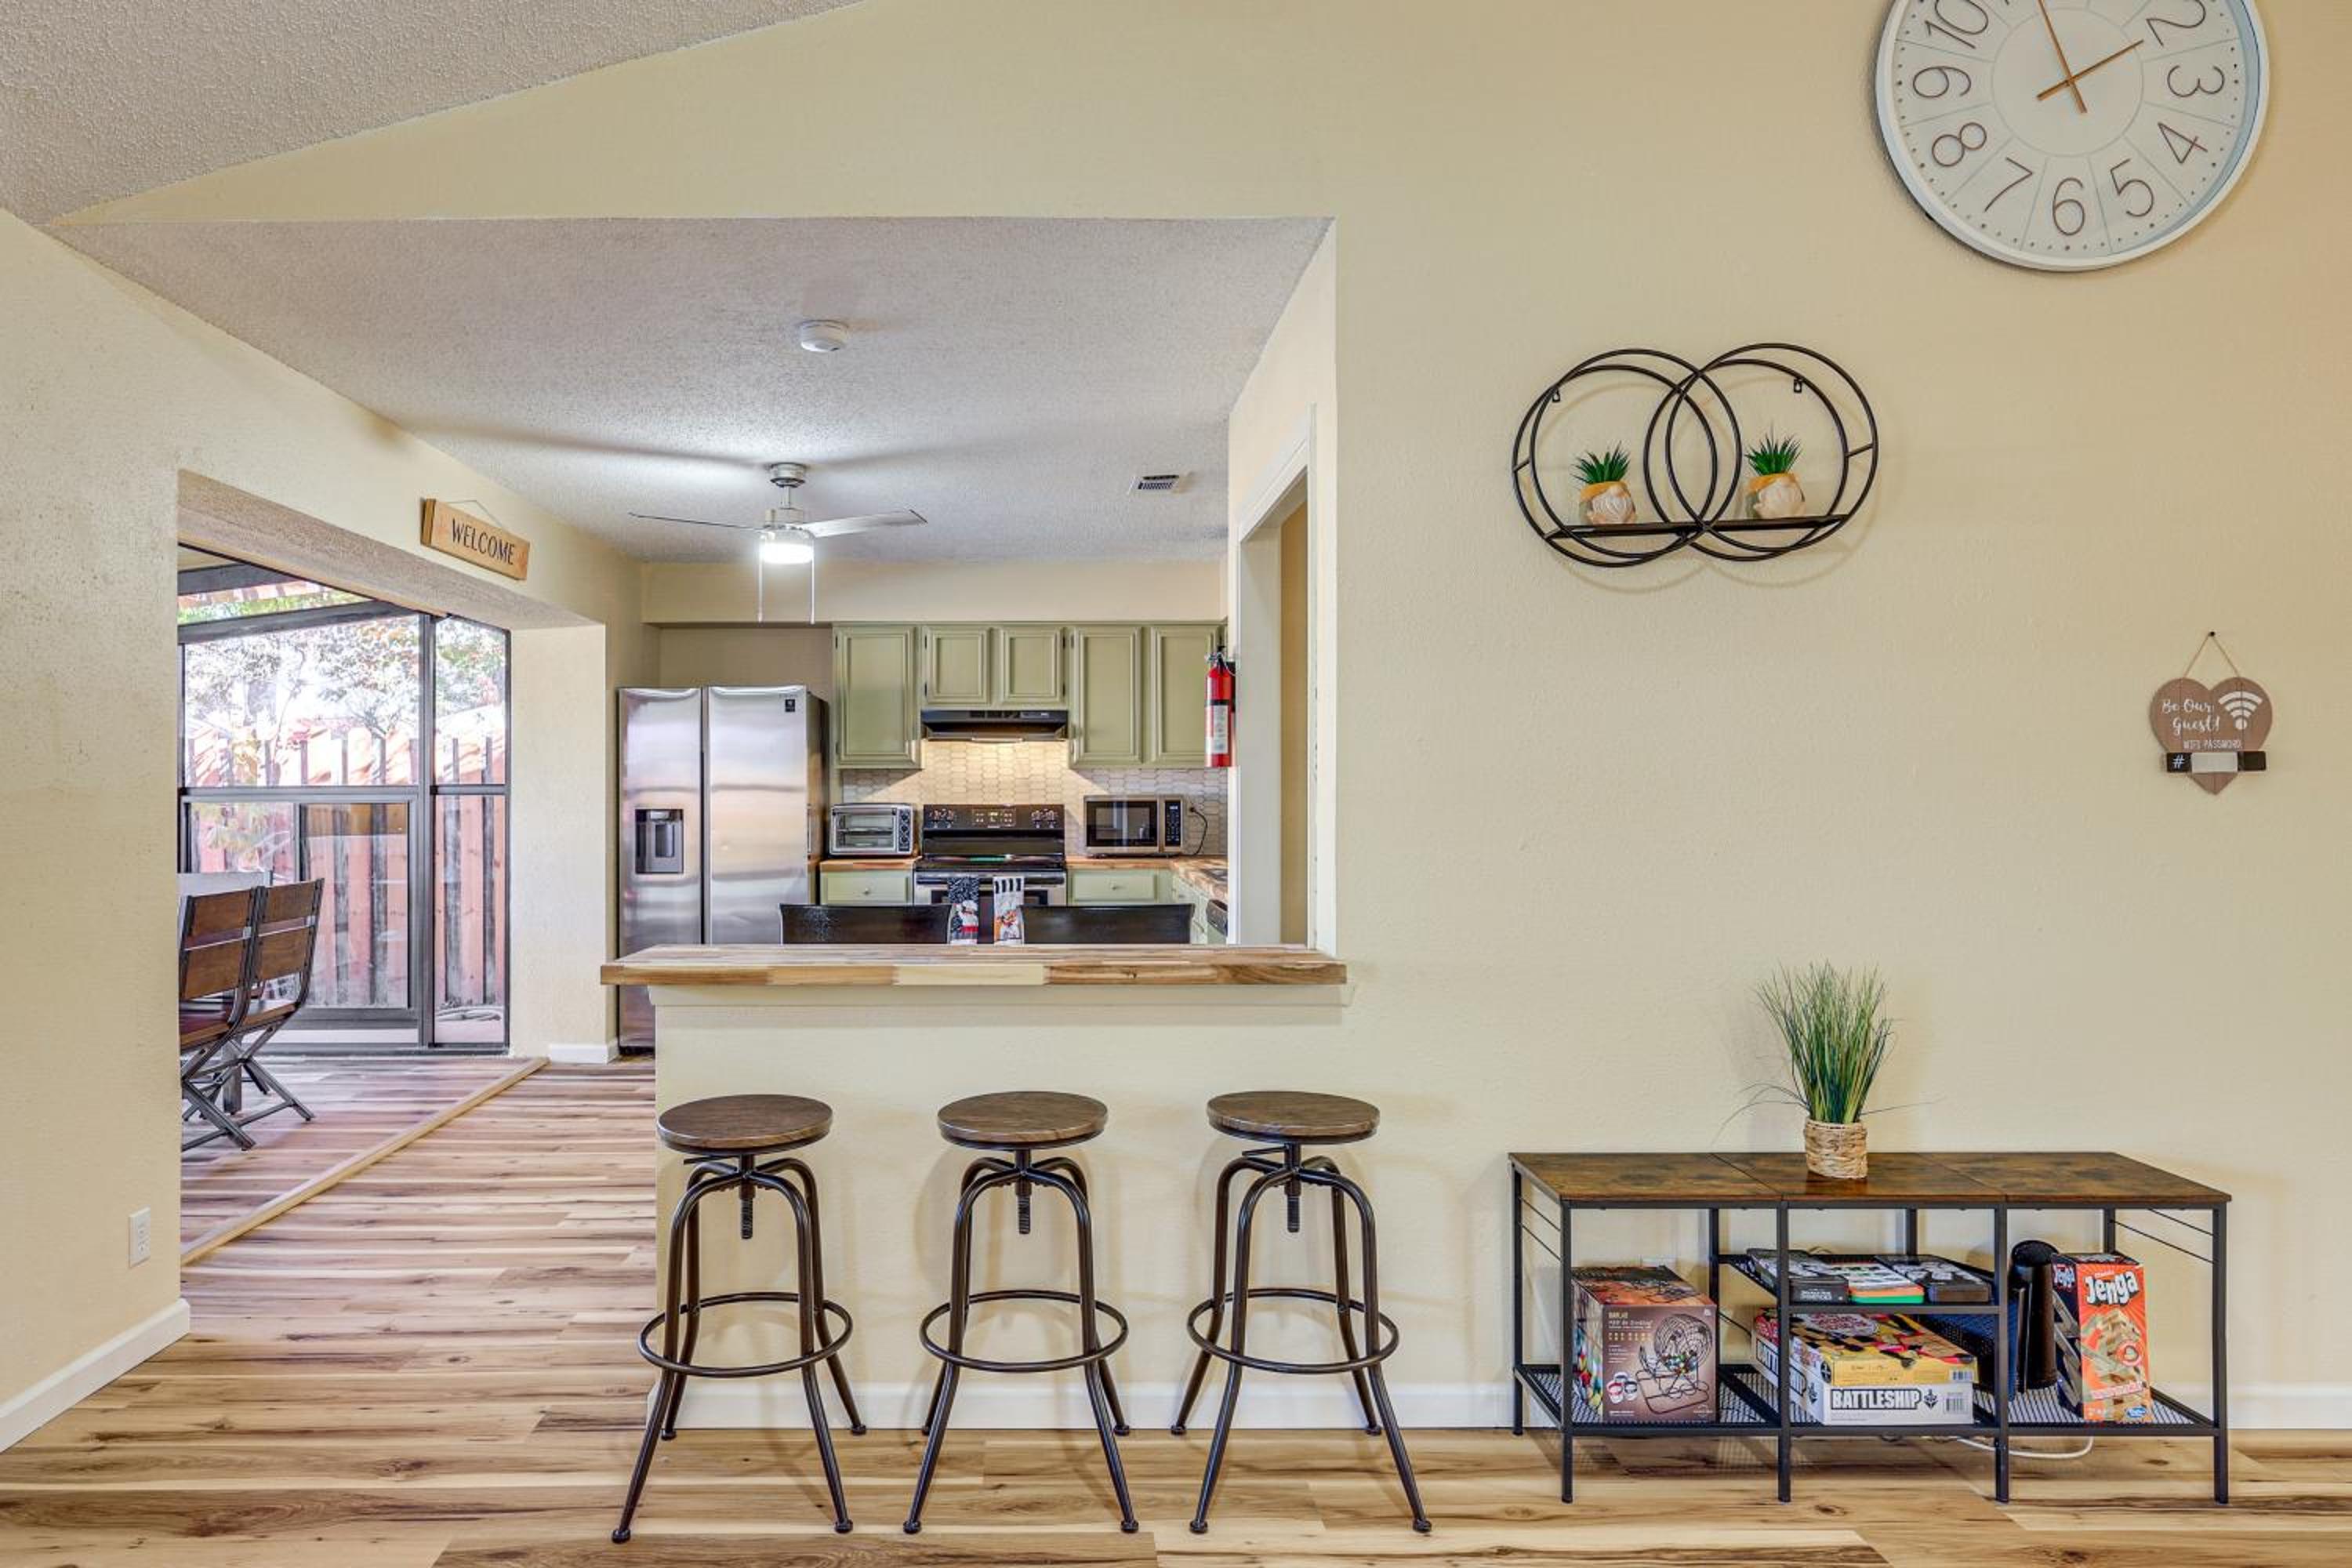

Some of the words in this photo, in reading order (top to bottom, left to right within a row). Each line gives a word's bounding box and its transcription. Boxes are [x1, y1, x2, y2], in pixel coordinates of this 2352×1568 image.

[1925, 0, 1989, 49] 10
[2146, 0, 2206, 47] 2
[1912, 65, 1972, 99] 9
[2166, 64, 2226, 98] 3
[1931, 122, 1987, 167] 8
[2158, 122, 2209, 165] 4
[1984, 157, 2034, 213] 7
[2052, 177, 2086, 236] 6
[2110, 158, 2154, 218] 5
[452, 517, 516, 565] WELCOME
[2183, 699, 2212, 714] Our
[2084, 1270, 2140, 1305] Jenga
[1831, 1389, 1922, 1410] BATTLESHIP
